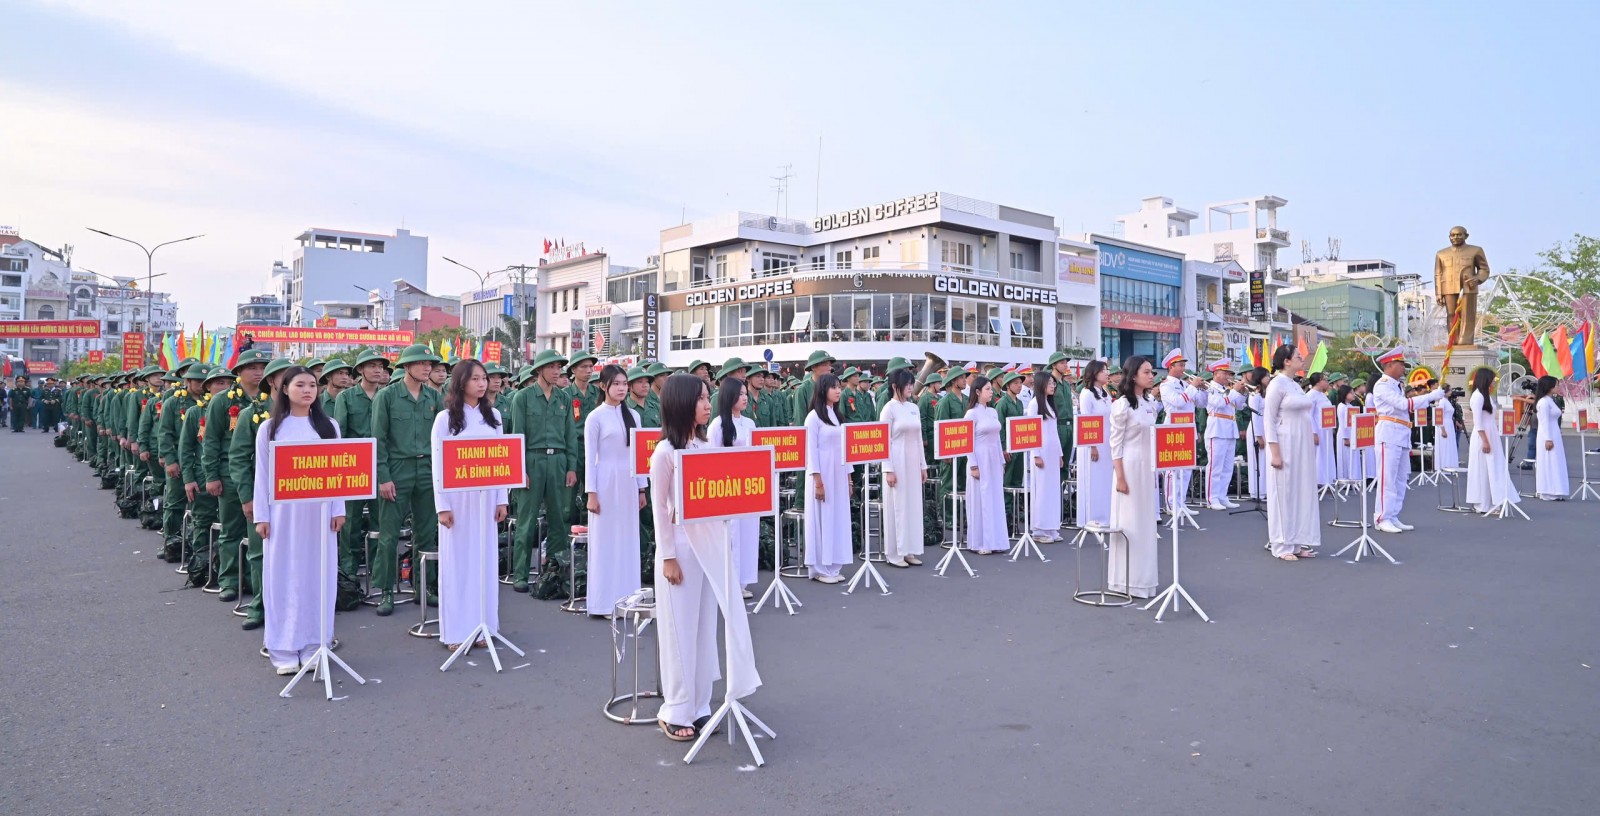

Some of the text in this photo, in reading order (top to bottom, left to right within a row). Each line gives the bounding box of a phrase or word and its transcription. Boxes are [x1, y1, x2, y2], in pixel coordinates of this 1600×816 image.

[812, 191, 938, 233] GOLDEN COFFEE
[686, 280, 795, 307] GOLDEN COFFEE
[935, 277, 1058, 305] GOLDEN COFFEE
[258, 329, 274, 338] CHIẾN
[300, 330, 314, 339] ĐỘNG
[316, 330, 322, 339] VÀ
[323, 331, 335, 340] HỌC
[335, 331, 345, 340] TẬP
[346, 332, 359, 340] THEO
[377, 333, 387, 341] BÁC
[388, 333, 395, 341] HỒ
[647, 310, 656, 356] GOLDEN
[944, 425, 968, 436] THANH NIÊN
[1015, 422, 1037, 432] THANH NIÊN
[761, 435, 797, 447] THANH NIÊN
[853, 429, 882, 440] THANH NIÊN
[1016, 435, 1021, 445] XÃ
[1166, 432, 1185, 446] BỘ ĐỘI
[851, 443, 884, 456] XÃ THOẠI SƠN
[944, 440, 951, 449] XÃ
[457, 444, 509, 460] THANH NIÊN
[782, 450, 799, 462] ĐĂNG
[1159, 448, 1192, 462] BIÊN PHÒNG
[292, 452, 357, 470] THANH NIÊN
[455, 463, 511, 479] XÃ BÌNH HÒA
[278, 472, 369, 492] PHƯỜNG MỸ THỚI
[690, 475, 766, 500] LỮ ĐOÀN 950
